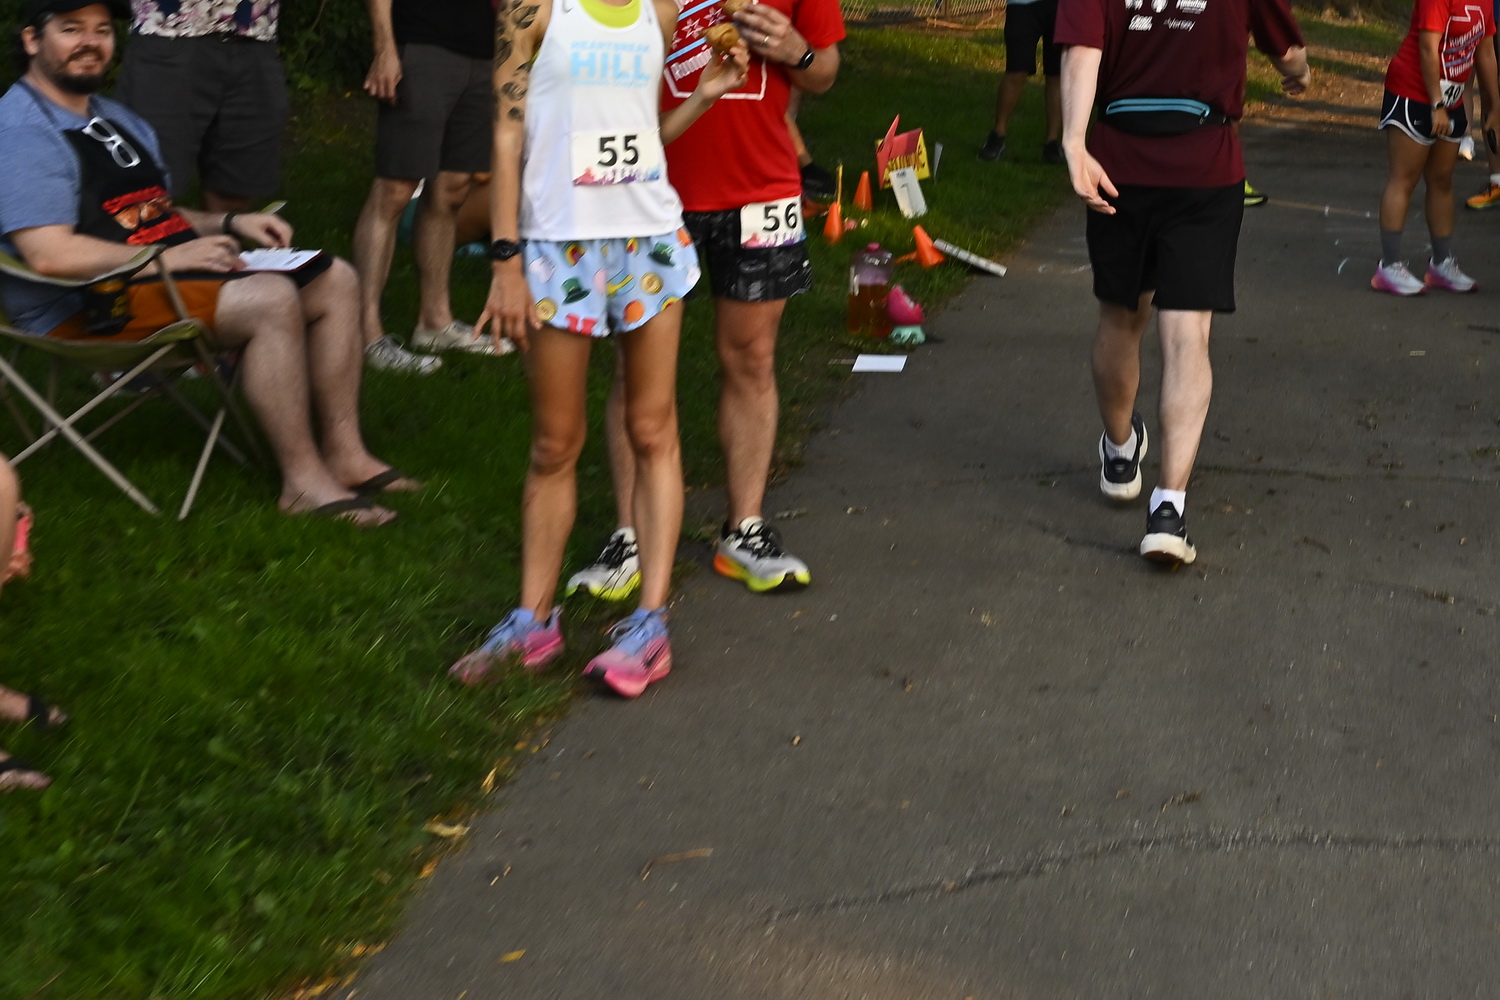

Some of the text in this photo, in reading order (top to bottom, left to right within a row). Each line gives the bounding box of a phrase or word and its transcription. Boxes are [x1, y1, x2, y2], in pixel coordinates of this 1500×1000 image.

[570, 51, 650, 81] HILL
[1443, 85, 1462, 102] 40
[596, 134, 640, 168] 55
[761, 202, 798, 233] 56
